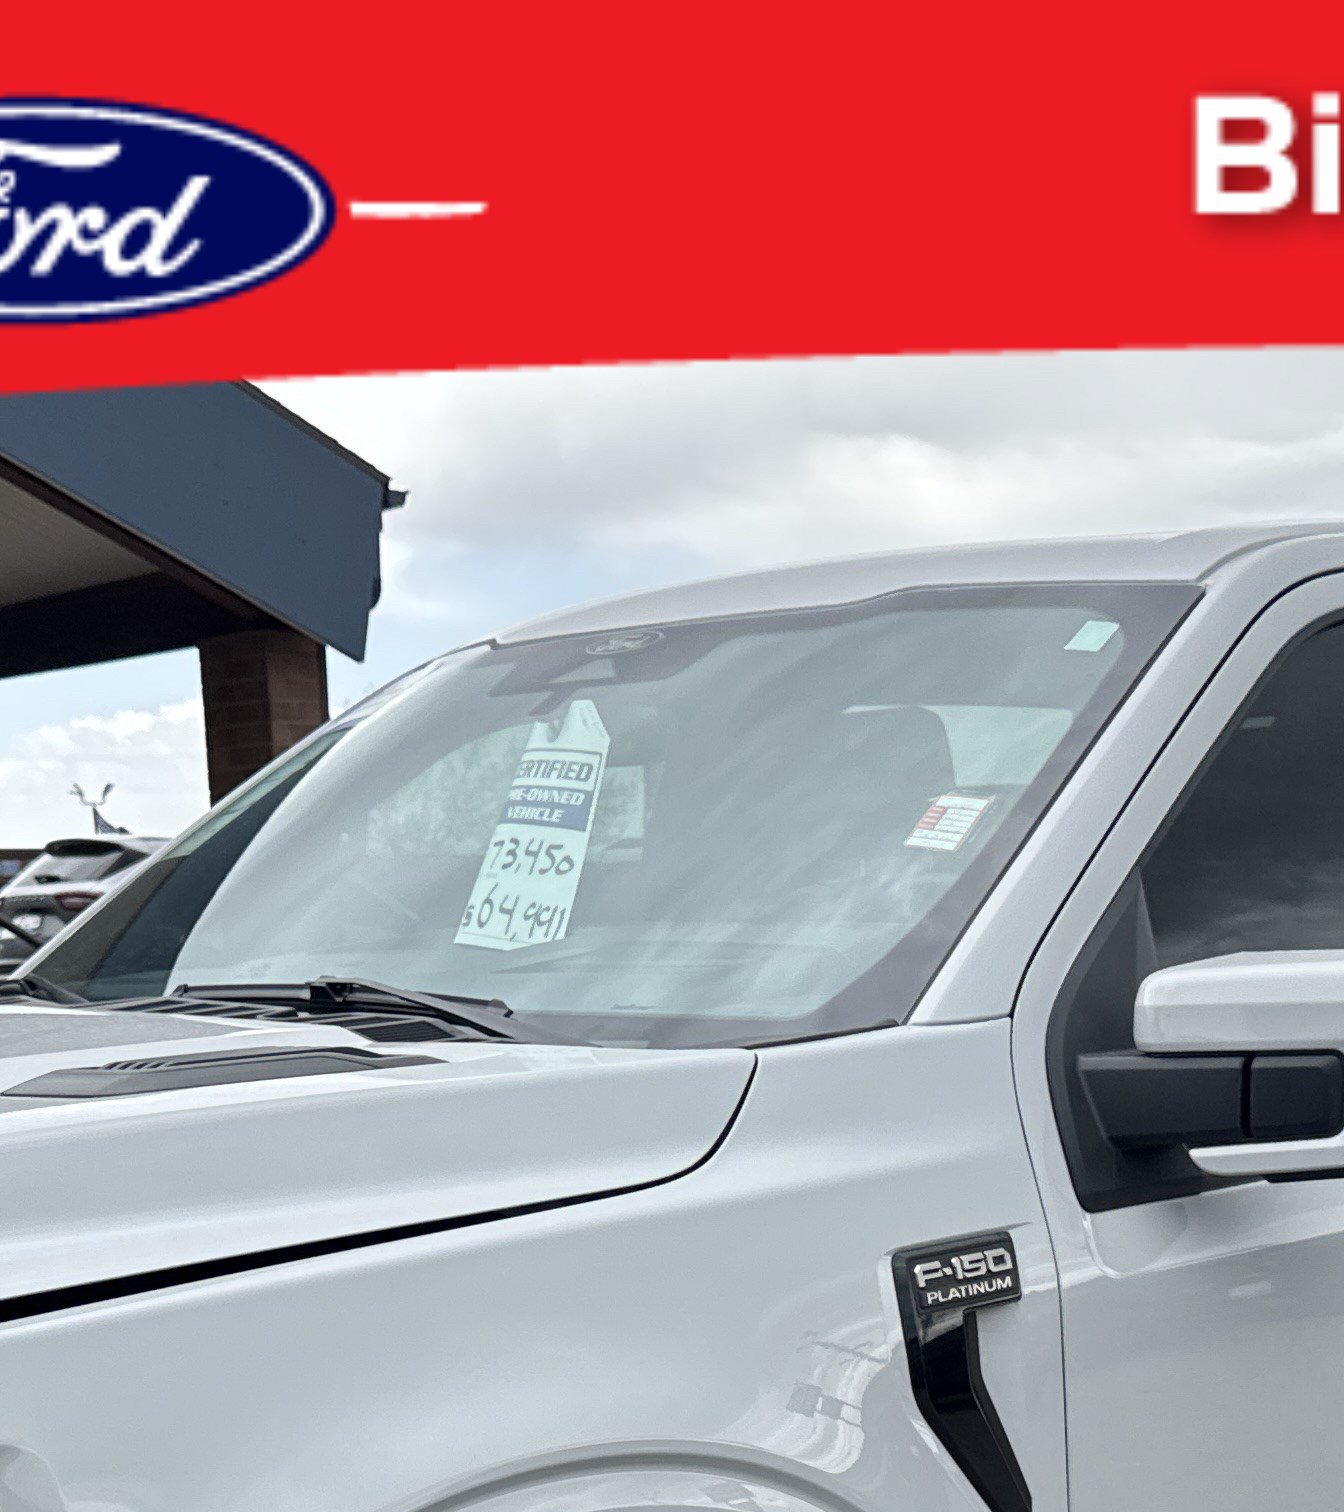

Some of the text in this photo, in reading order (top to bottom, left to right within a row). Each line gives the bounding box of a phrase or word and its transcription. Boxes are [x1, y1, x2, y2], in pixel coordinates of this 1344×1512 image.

[489, 837, 575, 876] 73,450
[913, 1247, 1014, 1288] F-150
[926, 1275, 1013, 1305] PLATINUM
